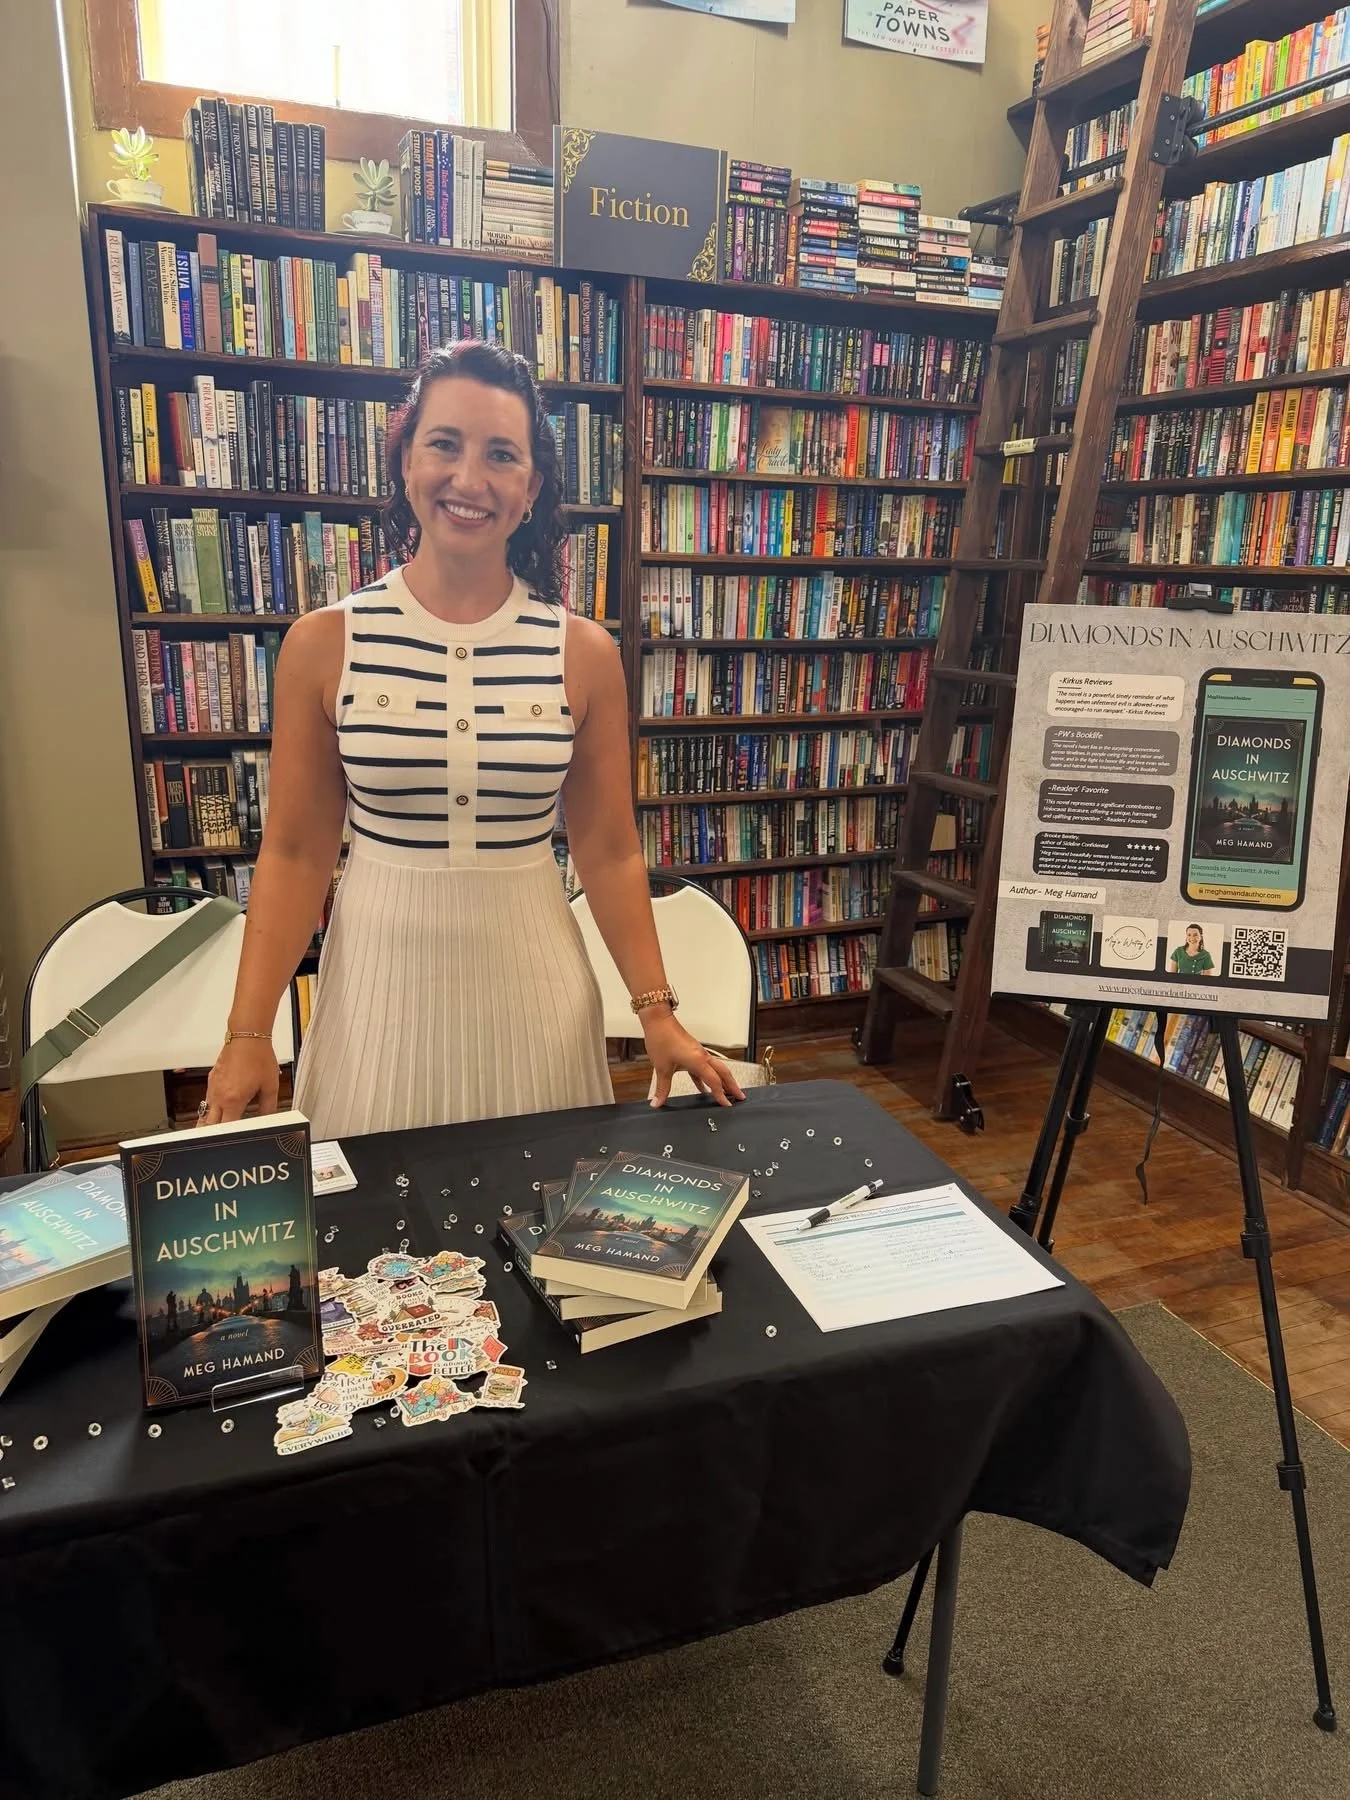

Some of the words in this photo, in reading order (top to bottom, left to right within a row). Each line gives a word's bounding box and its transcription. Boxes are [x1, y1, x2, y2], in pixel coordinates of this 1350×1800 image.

[884, 2, 939, 22] PAPER
[875, 14, 950, 42] TOWNS
[889, 37, 904, 45] YORK
[247, 106, 256, 124] SCOTT
[263, 108, 272, 126] SCOTT
[232, 122, 241, 157] TUROW
[248, 126, 258, 149] TUROW
[264, 128, 273, 149] TUROW
[223, 165, 231, 184] DEEPER
[249, 154, 260, 186] PLEADING
[264, 155, 275, 187] PLEADING
[251, 187, 262, 211] GUILTY
[266, 188, 277, 212] GUILTY
[589, 186, 690, 228] Fiction
[487, 232, 512, 240] MORRIS
[514, 235, 526, 245] The
[866, 236, 899, 248] TERMINAL
[167, 246, 175, 267] Frank
[494, 248, 527, 257] Investigation
[147, 270, 158, 293] EVE
[178, 260, 190, 289] SILVA
[170, 279, 178, 314] Slaughter
[430, 294, 438, 311] SMITH
[182, 313, 191, 338] CELLIST
[202, 382, 212, 402] ERICA
[1257, 403, 1266, 415] MARK
[1271, 402, 1280, 414] MARK
[1288, 399, 1297, 411] MARK
[203, 402, 214, 432] SPINDLER
[1254, 416, 1264, 434] GREANEY
[1269, 414, 1279, 432] GREANEY
[1285, 412, 1295, 431] GREANEY
[162, 521, 170, 545] DAVID
[360, 519, 371, 536] AMY
[324, 528, 332, 549] Rough
[362, 538, 372, 552] TAN
[137, 541, 146, 557] Help
[273, 545, 281, 566] spirits
[326, 551, 334, 565] Red
[587, 551, 595, 573] THOR
[161, 571, 170, 599] JUDGMENT
[167, 564, 175, 592] VENETIAN
[1283, 604, 1305, 612] JACKSON
[134, 634, 146, 659] BRAD
[148, 632, 159, 655] BRAD
[1030, 623, 1163, 647] DIAMONDS
[1170, 628, 1192, 648] IN
[1200, 629, 1350, 654] AUSCHWITZ
[232, 638, 241, 666] CHARLES
[136, 660, 148, 687] THOR
[151, 657, 161, 682] THOR
[234, 668, 242, 687] TODD
[197, 672, 207, 688] RED
[208, 668, 218, 697] SHOOTING
[1084, 678, 1112, 686] Reviews
[221, 676, 231, 704] TRACKING
[174, 687, 183, 723] ADMISSION
[199, 690, 208, 710] MESA
[210, 698, 219, 718] CHANT
[140, 698, 148, 724] APOSTLE
[223, 705, 232, 720] BEAR
[1217, 735, 1291, 750] DIAMONDS
[1246, 754, 1259, 764] IN
[1212, 769, 1290, 783] AUSCHWITZ
[146, 776, 156, 808] Investigation
[248, 776, 256, 802] TERMINAL
[1081, 786, 1109, 794] Favorite
[1237, 840, 1272, 848] HAMAND
[1045, 888, 1062, 898] Meg
[1065, 890, 1098, 899] Hamand
[1205, 889, 1281, 899] meghamandauthor.com
[1054, 913, 1086, 921] DIAMONDS
[1052, 928, 1086, 936] AUSCHWITZ
[1123, 939, 1144, 949] Writing
[156, 1162, 290, 1201] DIAMONDS
[622, 1164, 722, 1192] DIAMONDS
[655, 1183, 675, 1194] IN
[214, 1200, 238, 1222] IN
[600, 1187, 712, 1216] AUSCHWITZ
[74, 1207, 98, 1222] IN
[21, 1199, 98, 1250] AUSCHWITZ
[156, 1220, 296, 1263] AUSCHWITZ
[574, 1242, 601, 1252] MEG
[606, 1246, 660, 1263] HAMAND
[396, 1290, 424, 1300] BOOKS
[382, 1313, 441, 1331] OVERRATED
[228, 1328, 249, 1340] novel
[410, 1340, 447, 1352] The
[183, 1361, 216, 1378] MEG
[222, 1347, 286, 1371] HAMAND
[409, 1349, 473, 1363] BOOK
[433, 1364, 474, 1375] BETTER
[346, 1375, 375, 1386] Read
[347, 1385, 368, 1393] past
[314, 1400, 341, 1412] LOVE
[406, 1408, 447, 1424] Reading
[281, 1429, 351, 1453] EVERYWHERE
